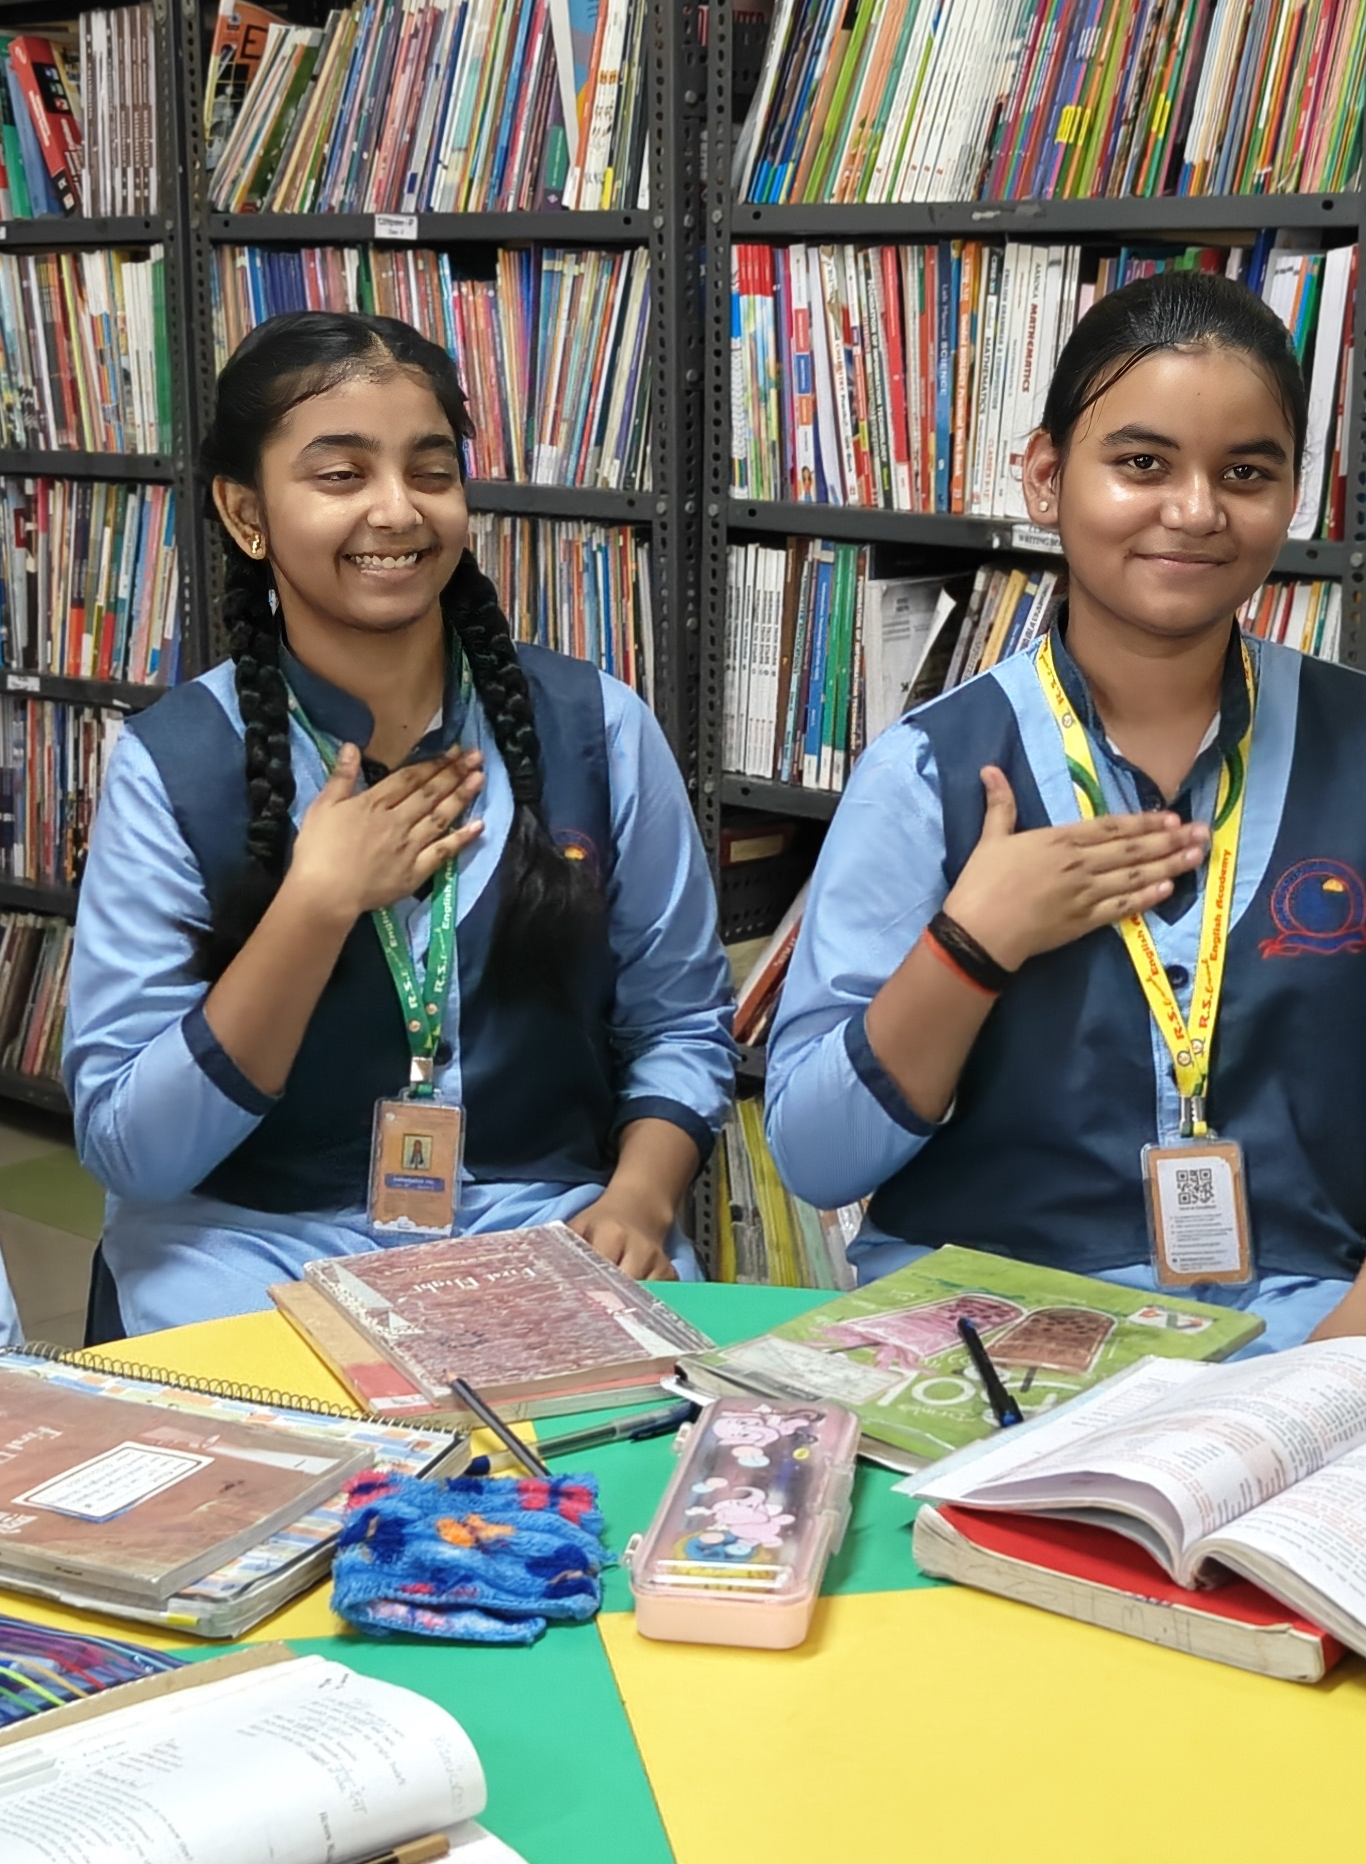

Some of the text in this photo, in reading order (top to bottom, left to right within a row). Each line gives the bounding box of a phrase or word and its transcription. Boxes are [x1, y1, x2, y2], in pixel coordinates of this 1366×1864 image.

[1001, 268, 1010, 301] ENGLISH
[940, 305, 948, 337] Manual
[1022, 303, 1039, 393] MATHEMATICS
[939, 341, 948, 396] SCIENCE
[958, 347, 967, 386] BIOLOGY
[979, 336, 991, 414] MATHEMATICS
[433, 884, 454, 992] R.S. English
[1198, 849, 1232, 1028] R.S. English Academy
[400, 972, 419, 1008] R.S.
[1134, 928, 1185, 1040] R.S. English
